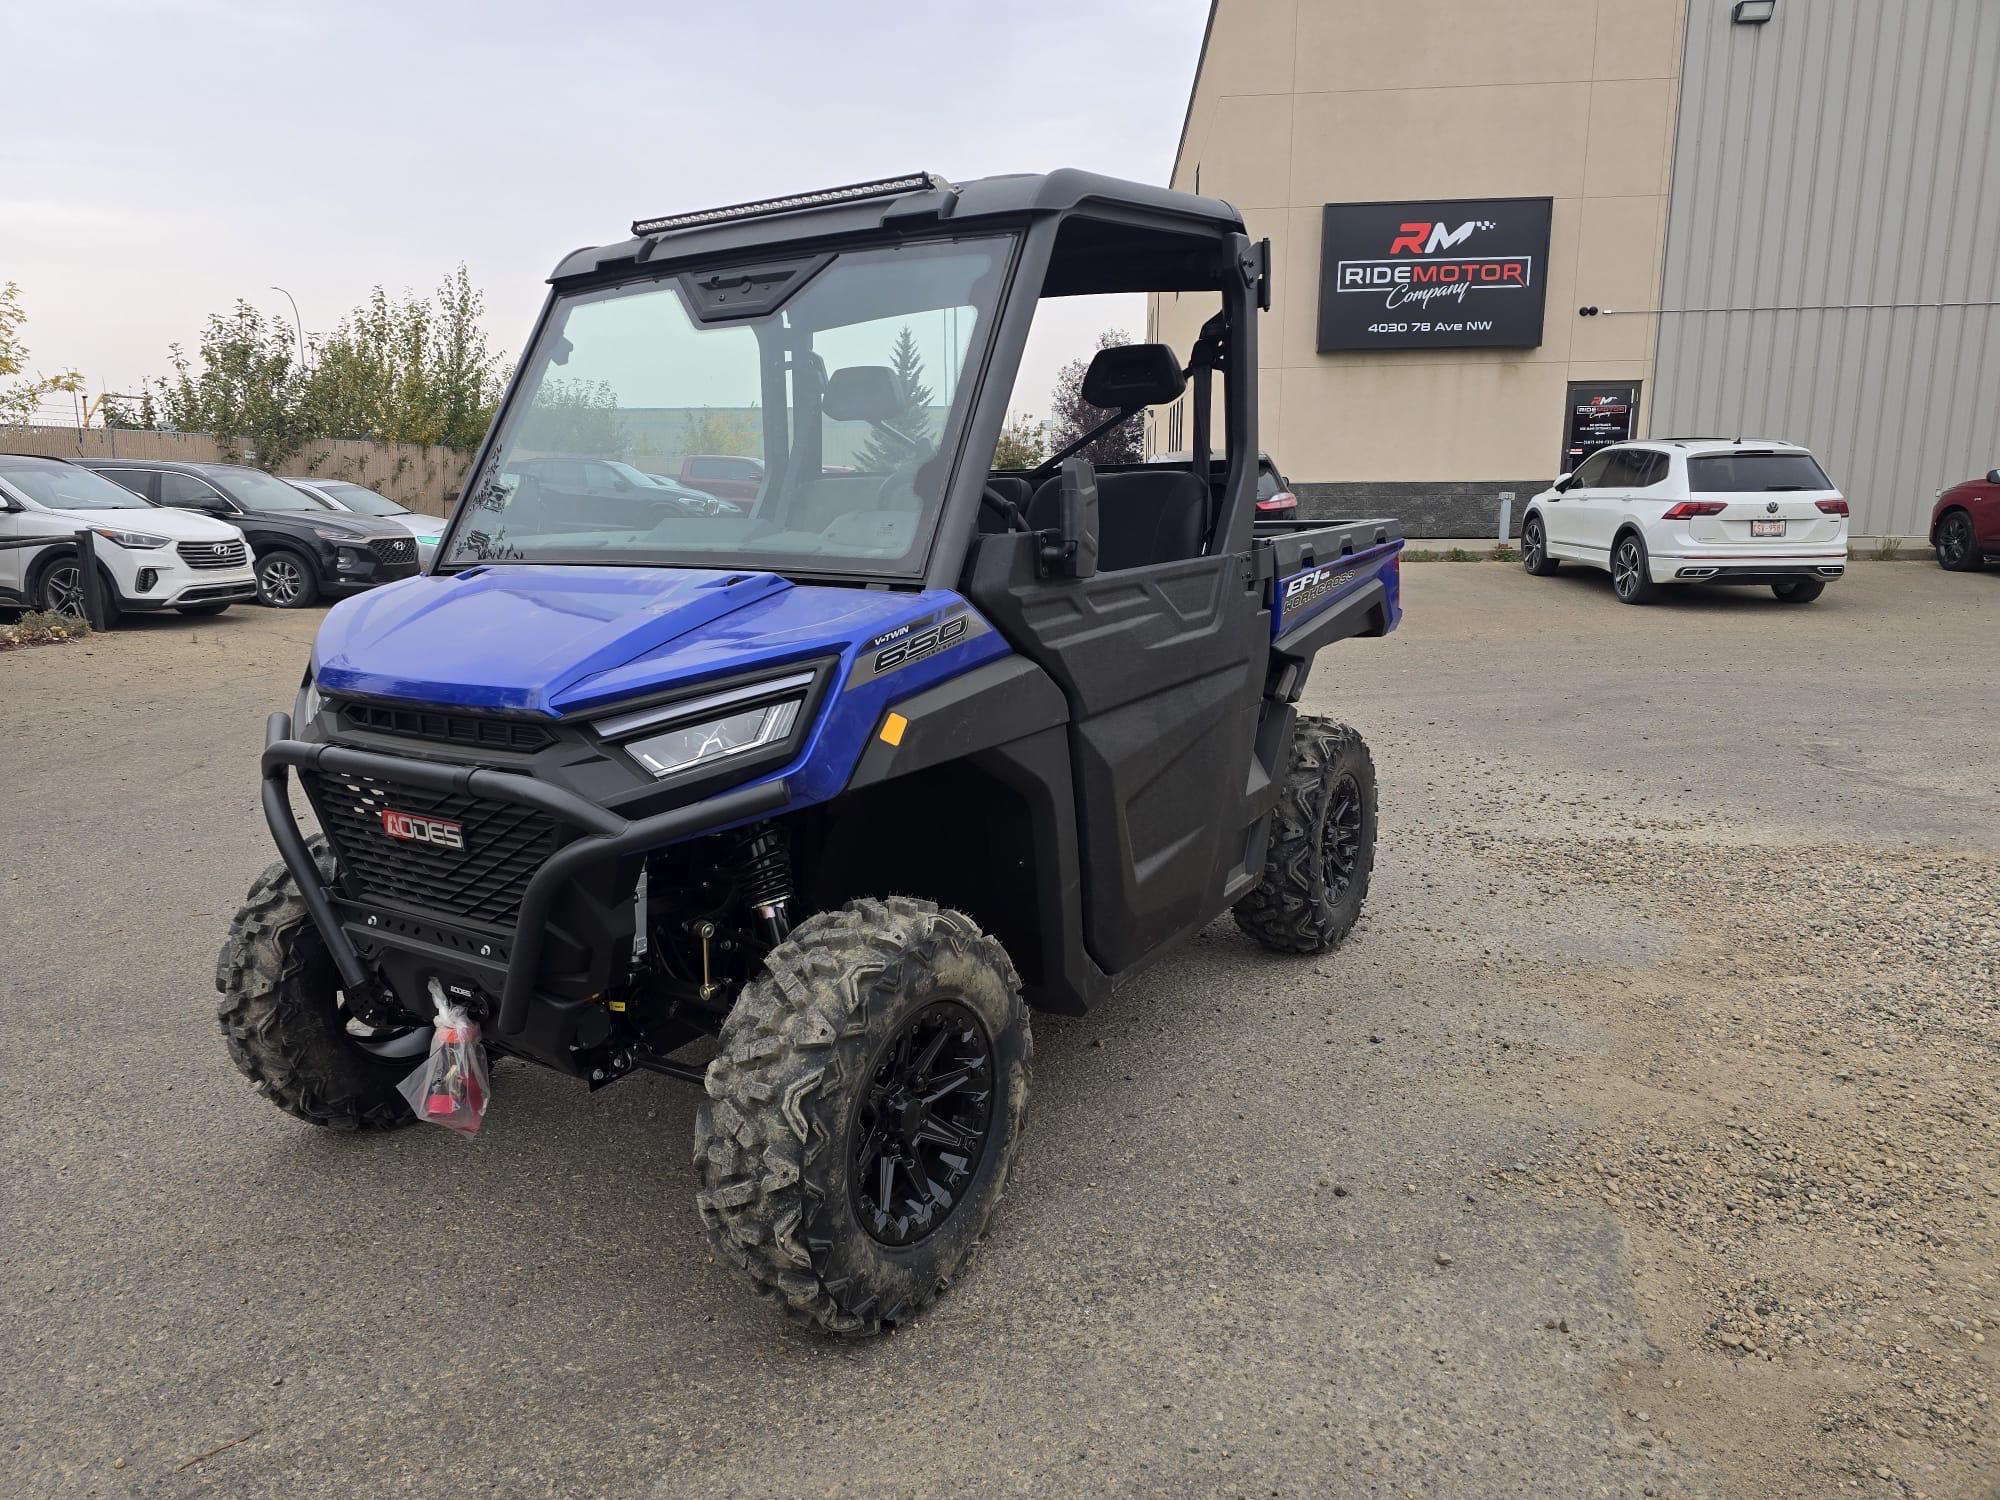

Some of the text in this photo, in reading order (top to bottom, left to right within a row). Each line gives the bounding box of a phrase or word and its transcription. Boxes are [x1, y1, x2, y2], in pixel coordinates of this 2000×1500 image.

[1390, 221, 1477, 254] RM
[1386, 281, 1471, 310] Company
[1367, 321, 1493, 334] 4030 78 Ave NW
[1286, 569, 1322, 597] EFI
[872, 613, 969, 675] 650
[874, 625, 910, 646] V-TWIN
[387, 814, 464, 849] AODES
